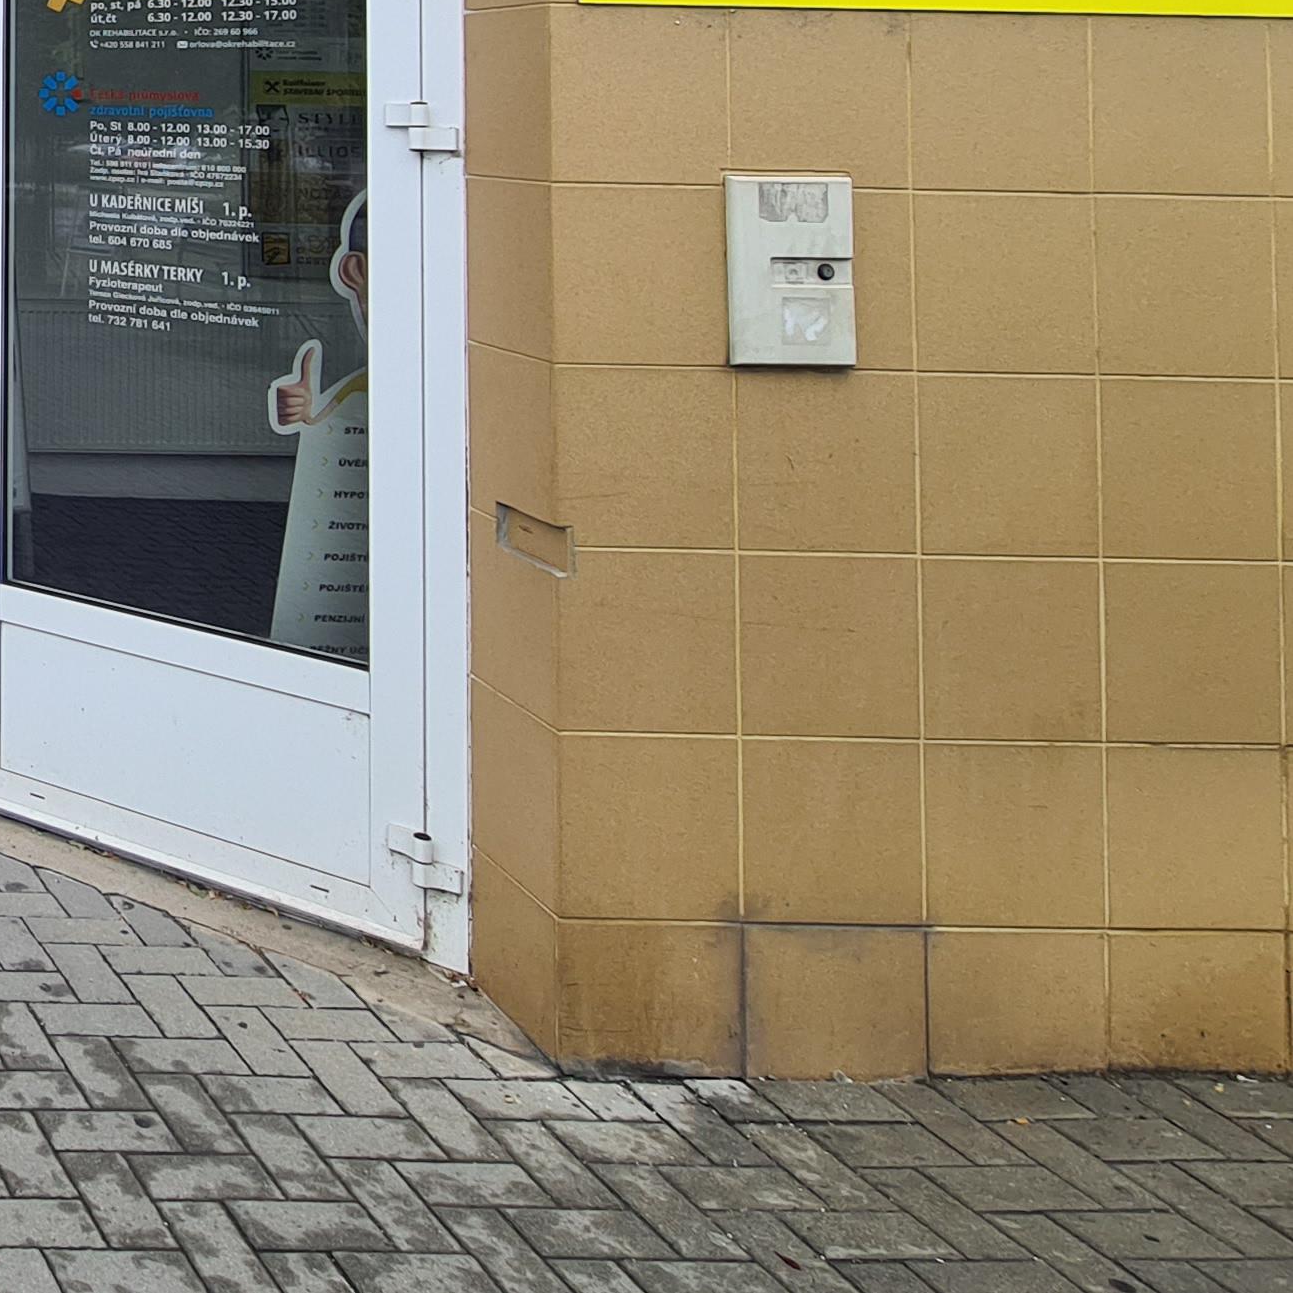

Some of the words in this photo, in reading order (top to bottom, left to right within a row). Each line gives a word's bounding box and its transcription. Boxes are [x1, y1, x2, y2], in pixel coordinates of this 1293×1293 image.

[147, 0, 171, 9] 6.30
[147, 12, 171, 22] 6.30
[181, 11, 212, 22] 12.00
[221, 10, 252, 21] 12.30
[264, 10, 297, 20] 17.00
[89, 121, 107, 133] Po,
[110, 121, 122, 131] St
[127, 122, 150, 132] 8.00
[161, 123, 190, 134] 12.00
[197, 124, 227, 135] 13.00
[238, 125, 270, 136] 17.00
[89, 133, 122, 146] Úterý
[127, 136, 150, 146] 8.00
[161, 136, 190, 147] 12.00
[197, 137, 227, 148] 13.00
[238, 138, 270, 150] 15.30
[179, 148, 202, 160] den
[89, 193, 98, 207] U
[101, 194, 172, 213] KADEŘNICE
[175, 196, 204, 214] MÍŠI
[222, 202, 235, 216] 1.
[238, 206, 253, 221] p.
[88, 235, 106, 245] tel.
[89, 221, 137, 235] Provozní
[140, 223, 167, 236] doba
[170, 226, 188, 238] dle
[191, 229, 260, 244] objednávek
[89, 259, 98, 272] U
[100, 260, 160, 279] MASÉRKY
[161, 265, 204, 283] TERKY
[221, 271, 235, 286] 1.
[237, 275, 252, 290] p.
[89, 276, 163, 294] Fyzioterapeut
[88, 300, 137, 315] Provozní
[139, 305, 167, 318] doba
[170, 309, 188, 321] dle
[191, 312, 259, 328] objednávek
[88, 314, 105, 324] tel.
